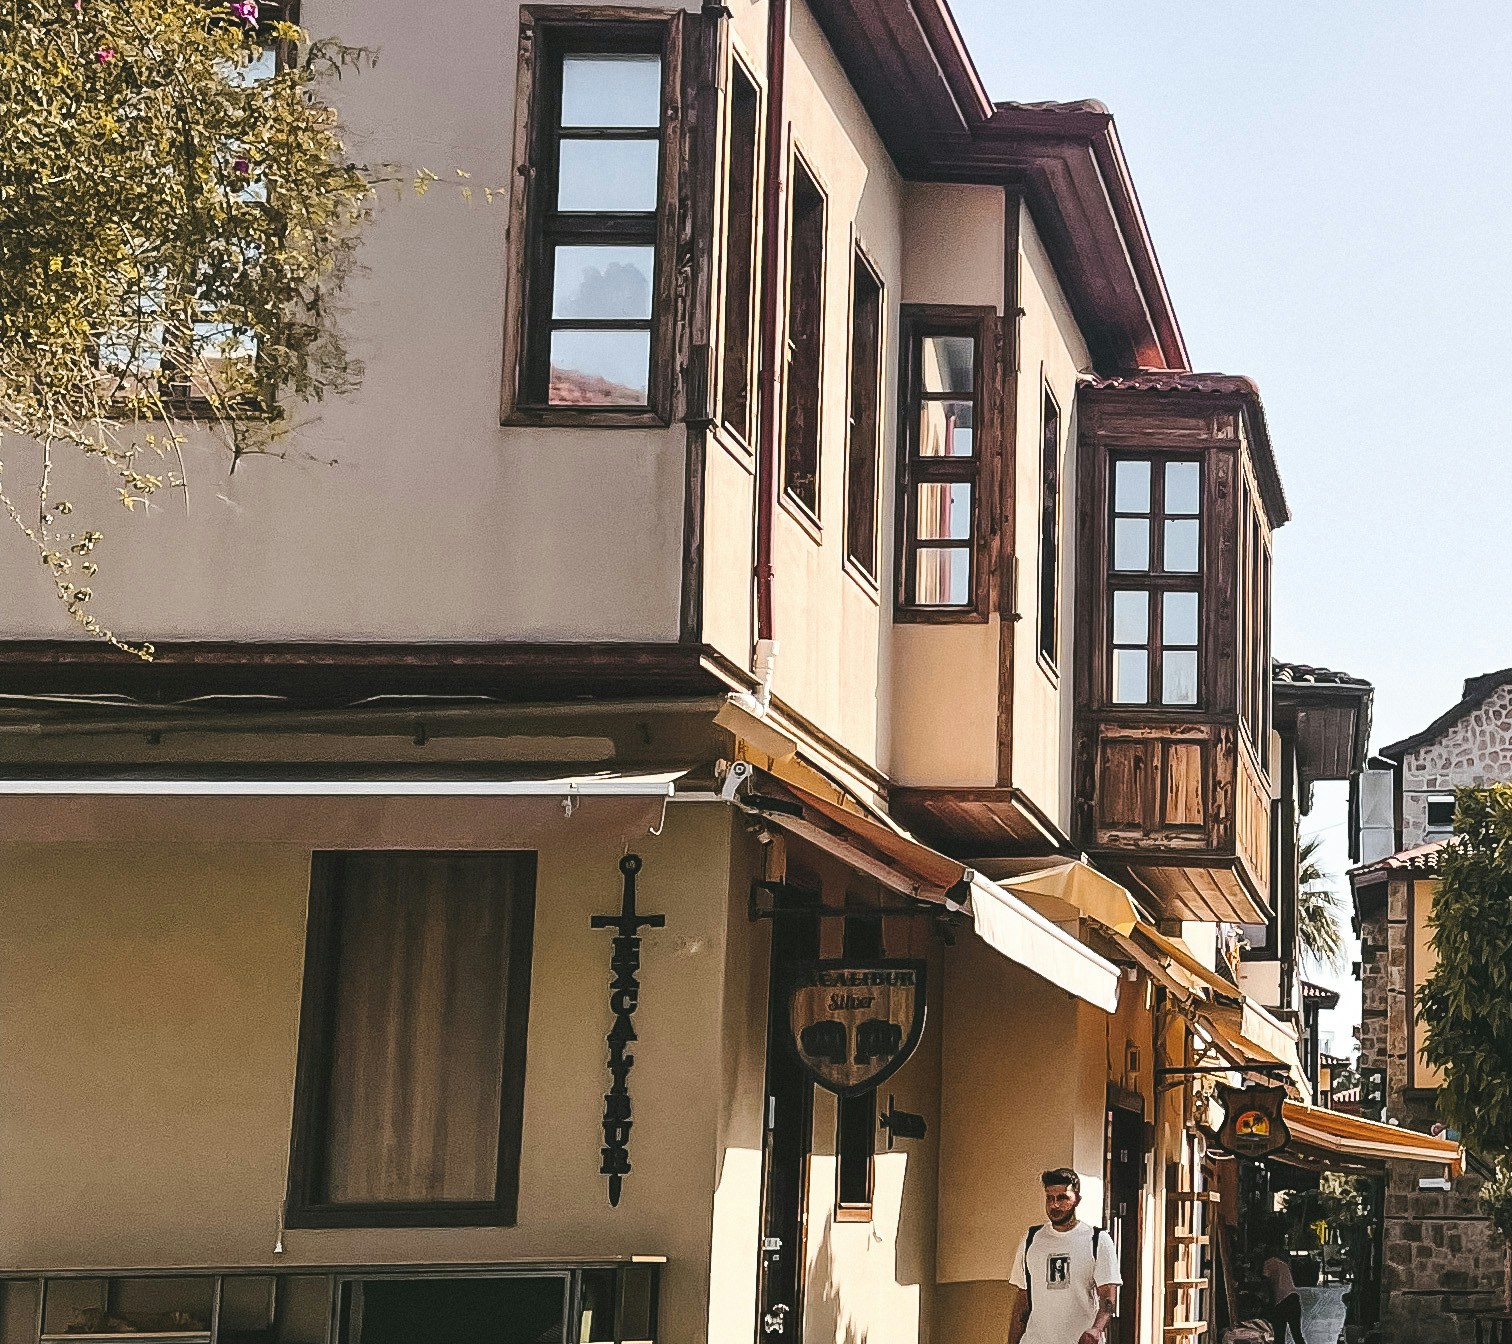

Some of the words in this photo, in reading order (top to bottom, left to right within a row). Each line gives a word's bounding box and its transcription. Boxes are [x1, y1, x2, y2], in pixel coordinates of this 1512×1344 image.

[797, 971, 916, 987] XCALIBUR
[828, 991, 875, 1011] Silver
[600, 937, 641, 1175] EXCALIBUR
